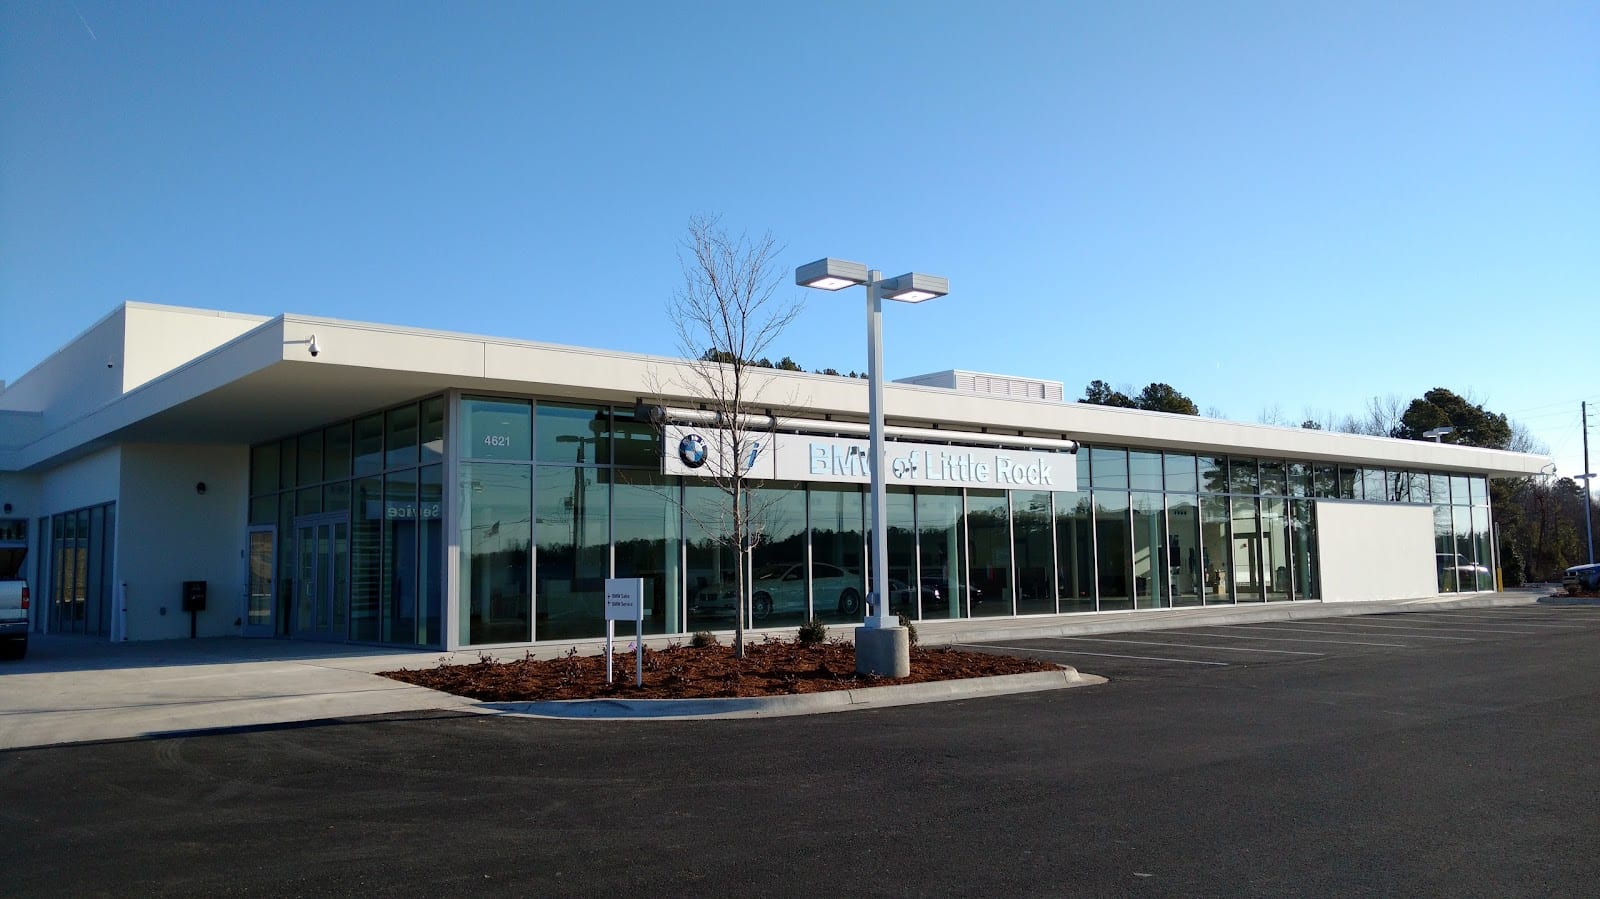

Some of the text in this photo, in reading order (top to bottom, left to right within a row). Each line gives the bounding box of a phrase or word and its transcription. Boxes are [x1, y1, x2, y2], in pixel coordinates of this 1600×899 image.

[484, 435, 510, 447] 4621
[892, 449, 919, 480] of
[925, 450, 989, 483] Little
[995, 455, 1054, 486] Rock
